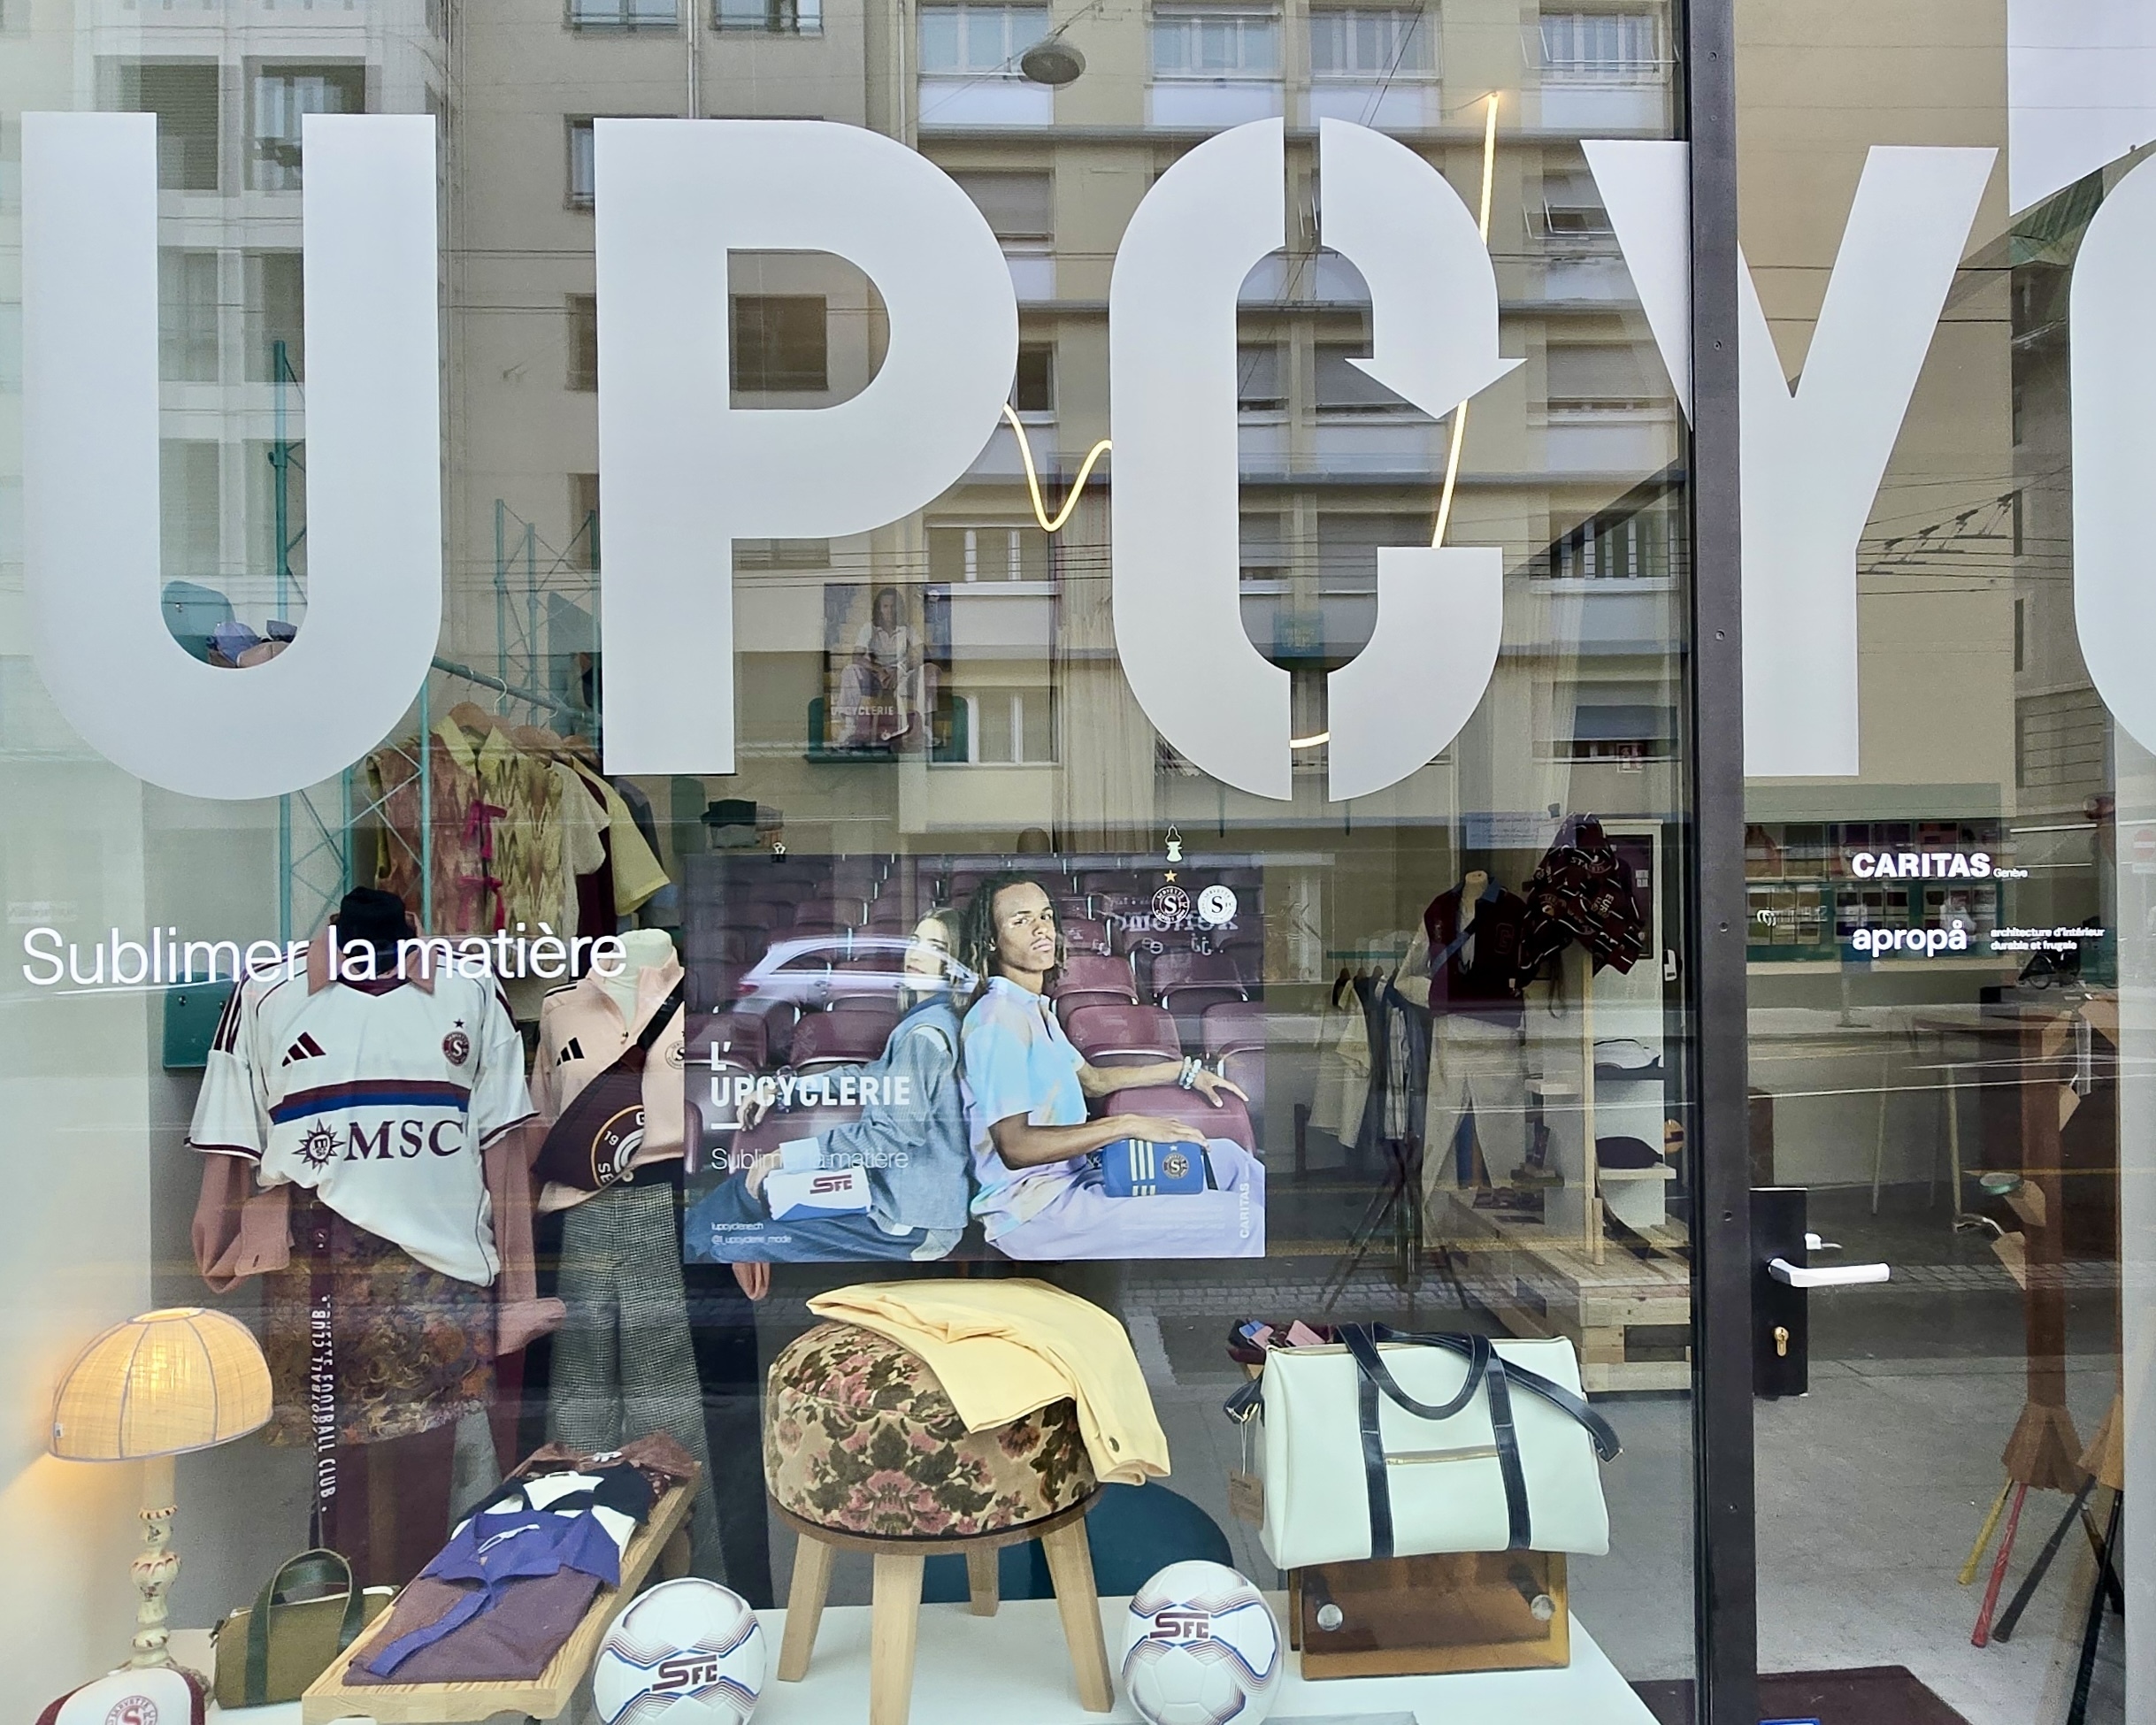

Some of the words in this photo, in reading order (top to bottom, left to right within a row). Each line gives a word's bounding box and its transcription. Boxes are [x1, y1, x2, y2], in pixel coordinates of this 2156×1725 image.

[1852, 852, 1991, 878] CARITAS
[1852, 919, 1968, 958] apropå
[1991, 927, 2052, 938] architecture
[1991, 940, 2029, 950] durable
[2030, 940, 2043, 950] et
[2043, 940, 2078, 952] frugale
[22, 926, 310, 985] Sublimer
[327, 924, 378, 981] la
[396, 922, 628, 981] matière
[710, 1041, 732, 1071] L'
[710, 1076, 911, 1107] UPCYCLERIE
[343, 1119, 464, 1162] MSC
[1239, 1182, 1250, 1238] CARITAS
[311, 1309, 326, 1349] CLUB
[318, 1458, 336, 1499] CLUB
[1150, 1613, 1208, 1639] SFC
[652, 1654, 717, 1691] SFC
